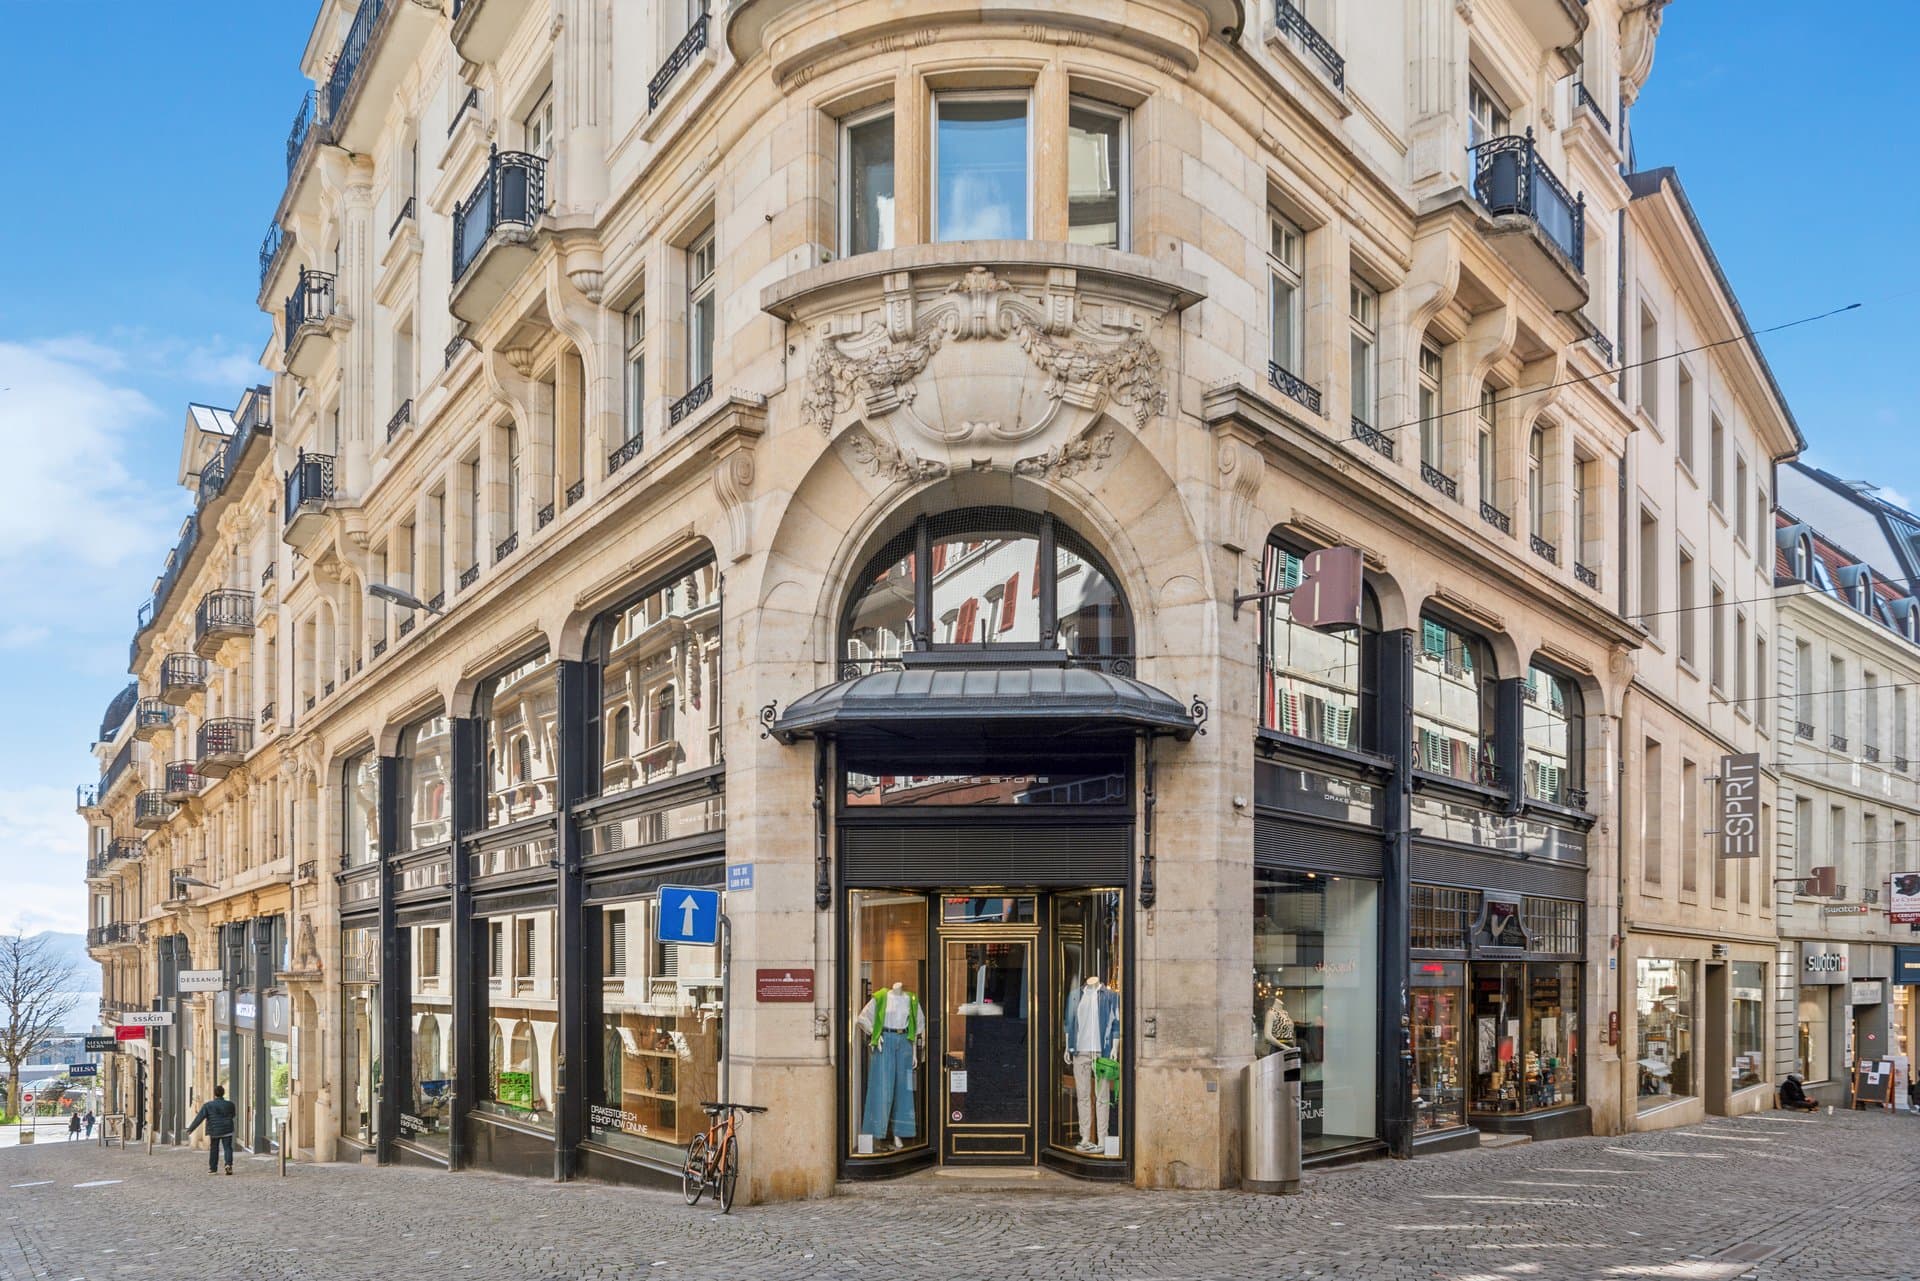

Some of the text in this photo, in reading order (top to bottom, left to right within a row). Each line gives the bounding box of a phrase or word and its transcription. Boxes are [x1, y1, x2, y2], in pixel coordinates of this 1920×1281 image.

[990, 776, 1049, 784] STORE
[1725, 759, 1754, 854] ESPRIT
[1806, 953, 1840, 971] swatch
[180, 976, 221, 984] DESSANGE
[611, 1117, 626, 1129] NOW
[626, 1120, 649, 1134] ONLINE
